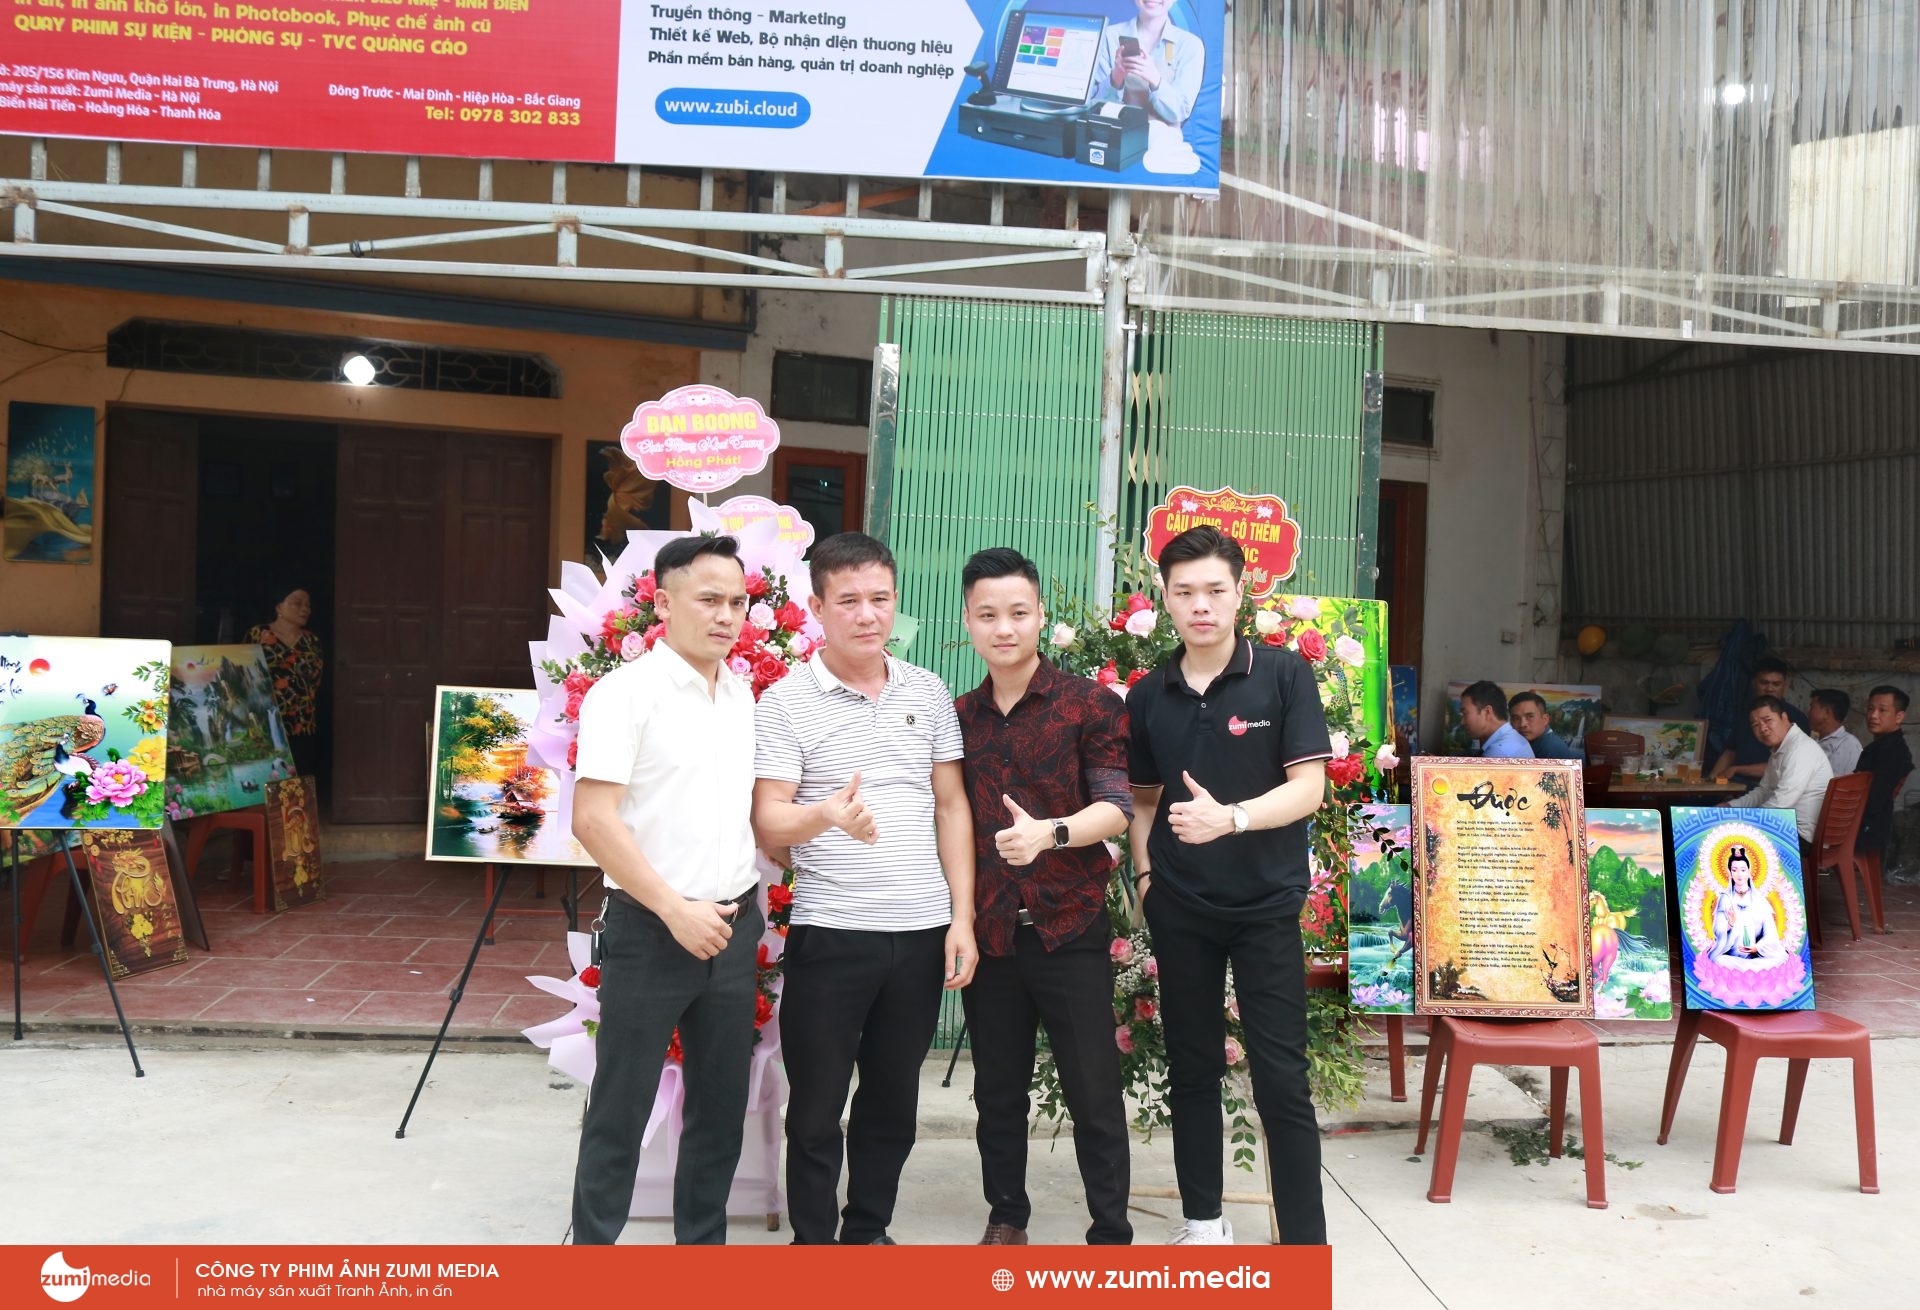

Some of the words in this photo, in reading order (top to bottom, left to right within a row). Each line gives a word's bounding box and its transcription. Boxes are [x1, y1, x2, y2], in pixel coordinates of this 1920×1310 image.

[213, 3, 230, 19] in
[236, 4, 340, 26] Photobook,
[347, 11, 390, 31] Phục
[471, 19, 492, 33] cũ
[707, 7, 752, 25] thông
[769, 9, 846, 29] Marketing
[14, 14, 65, 32] QUAY
[72, 18, 118, 36] PHIM
[152, 22, 192, 43] KIỆN
[322, 33, 356, 50] TVC
[650, 26, 687, 42] Thiết
[692, 27, 712, 42] kế
[717, 30, 753, 46] Web,
[759, 32, 779, 49] Bộ
[784, 33, 820, 50] nhận
[825, 35, 858, 52] diện
[863, 37, 916, 55] thương
[921, 40, 953, 57] hiệu
[12, 65, 65, 81] 205/156
[66, 68, 90, 82] Kim
[130, 71, 160, 88] Quận
[162, 74, 182, 87] Hai
[184, 76, 200, 88] Bà
[241, 79, 257, 92] Hà
[258, 80, 279, 95] Nội
[758, 55, 795, 72] hàng,
[840, 59, 855, 75] trị
[859, 60, 903, 75] doanh
[907, 63, 954, 80] nghiệp
[83, 85, 113, 99] Zumi
[115, 87, 152, 102] Media
[161, 90, 178, 103] Hà
[179, 91, 200, 105] Nội
[328, 84, 360, 100] Đông
[403, 88, 425, 100] Mai
[463, 91, 489, 106] Hiệp
[491, 92, 514, 105] Hòa
[547, 94, 580, 110] Giang
[160, 105, 196, 119] Thanh
[425, 105, 455, 120] Tel:
[460, 107, 504, 123] 0978
[509, 109, 542, 125] 302
[547, 111, 581, 126] 833
[664, 99, 798, 117] www.zubi.cloud
[691, 411, 757, 432] BOONG
[1166, 510, 1189, 536] CẬU
[1231, 518, 1248, 540] CÔ
[1249, 521, 1281, 544] THÊM
